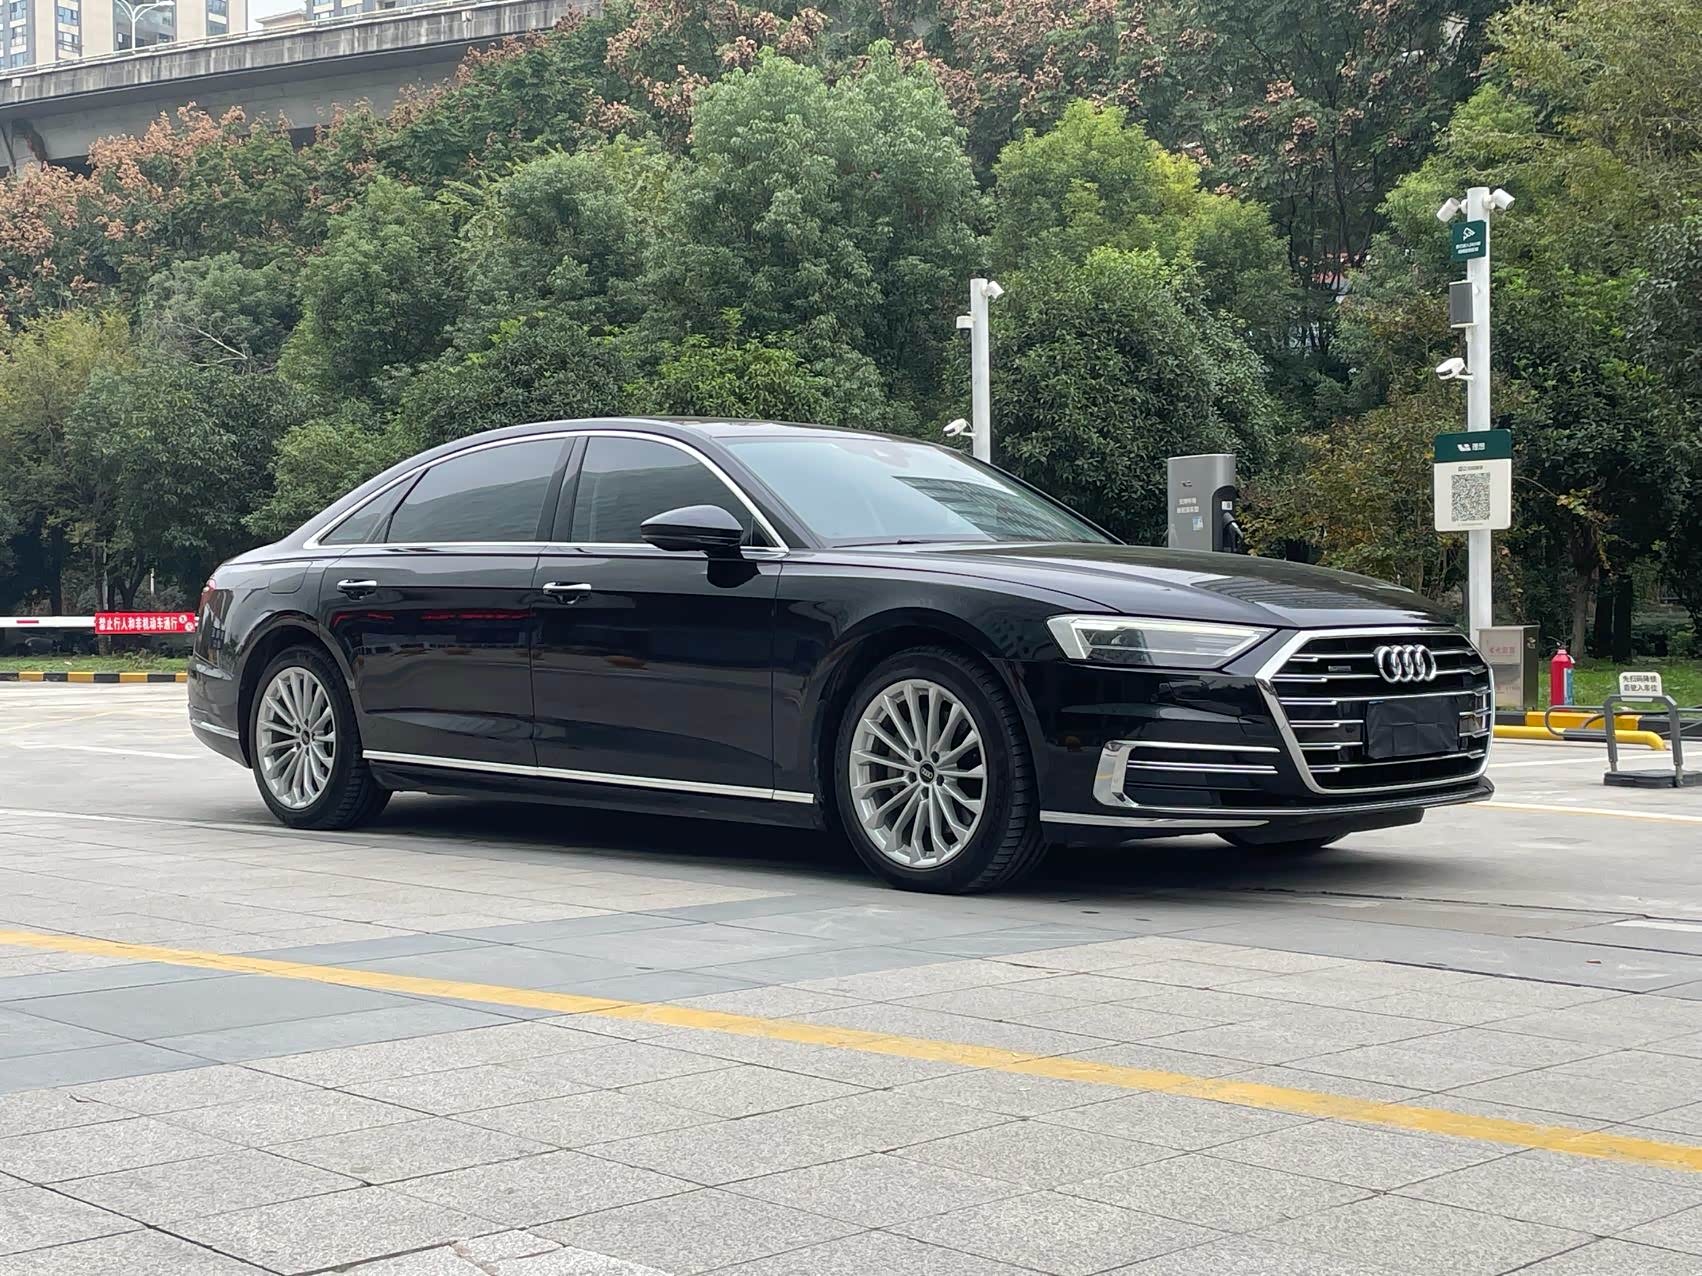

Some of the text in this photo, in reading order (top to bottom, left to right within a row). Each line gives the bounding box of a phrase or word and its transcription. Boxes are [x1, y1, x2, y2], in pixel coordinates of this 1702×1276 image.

[98, 616, 177, 631] 禁止行人和非机动车通行
